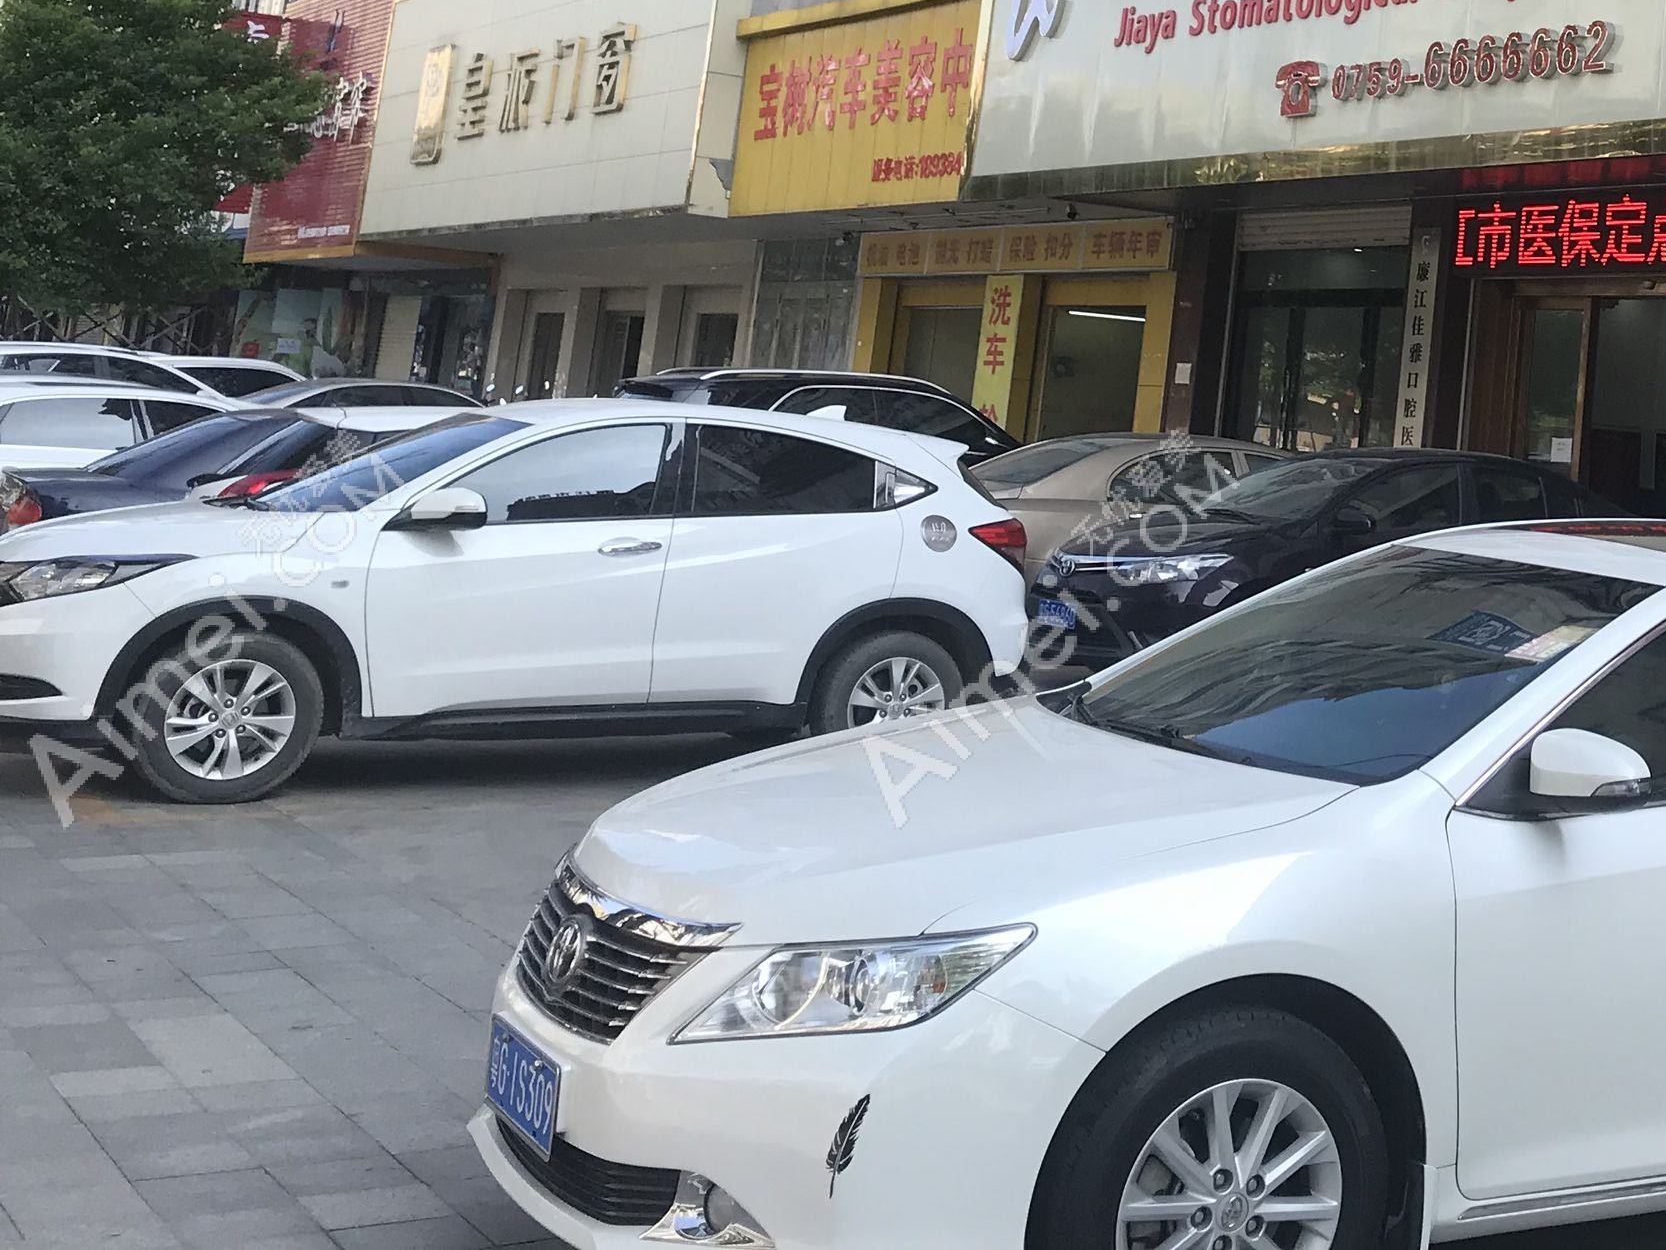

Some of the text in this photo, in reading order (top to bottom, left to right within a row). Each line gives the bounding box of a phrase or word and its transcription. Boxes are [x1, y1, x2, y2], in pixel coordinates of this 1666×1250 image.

[1114, 4, 1177, 55] Jiaya
[1331, 20, 1612, 100] 0759-6666662
[456, 21, 638, 141] 皇派门窗
[754, 27, 973, 142] 宝树汽车美容中
[1008, 233, 1038, 262] 保险
[1044, 231, 1074, 262] 扣分
[1091, 230, 1163, 261] 车辆年审
[983, 284, 1013, 375] 洗车
[1400, 261, 1430, 447] 廉江佳雅口腔医
